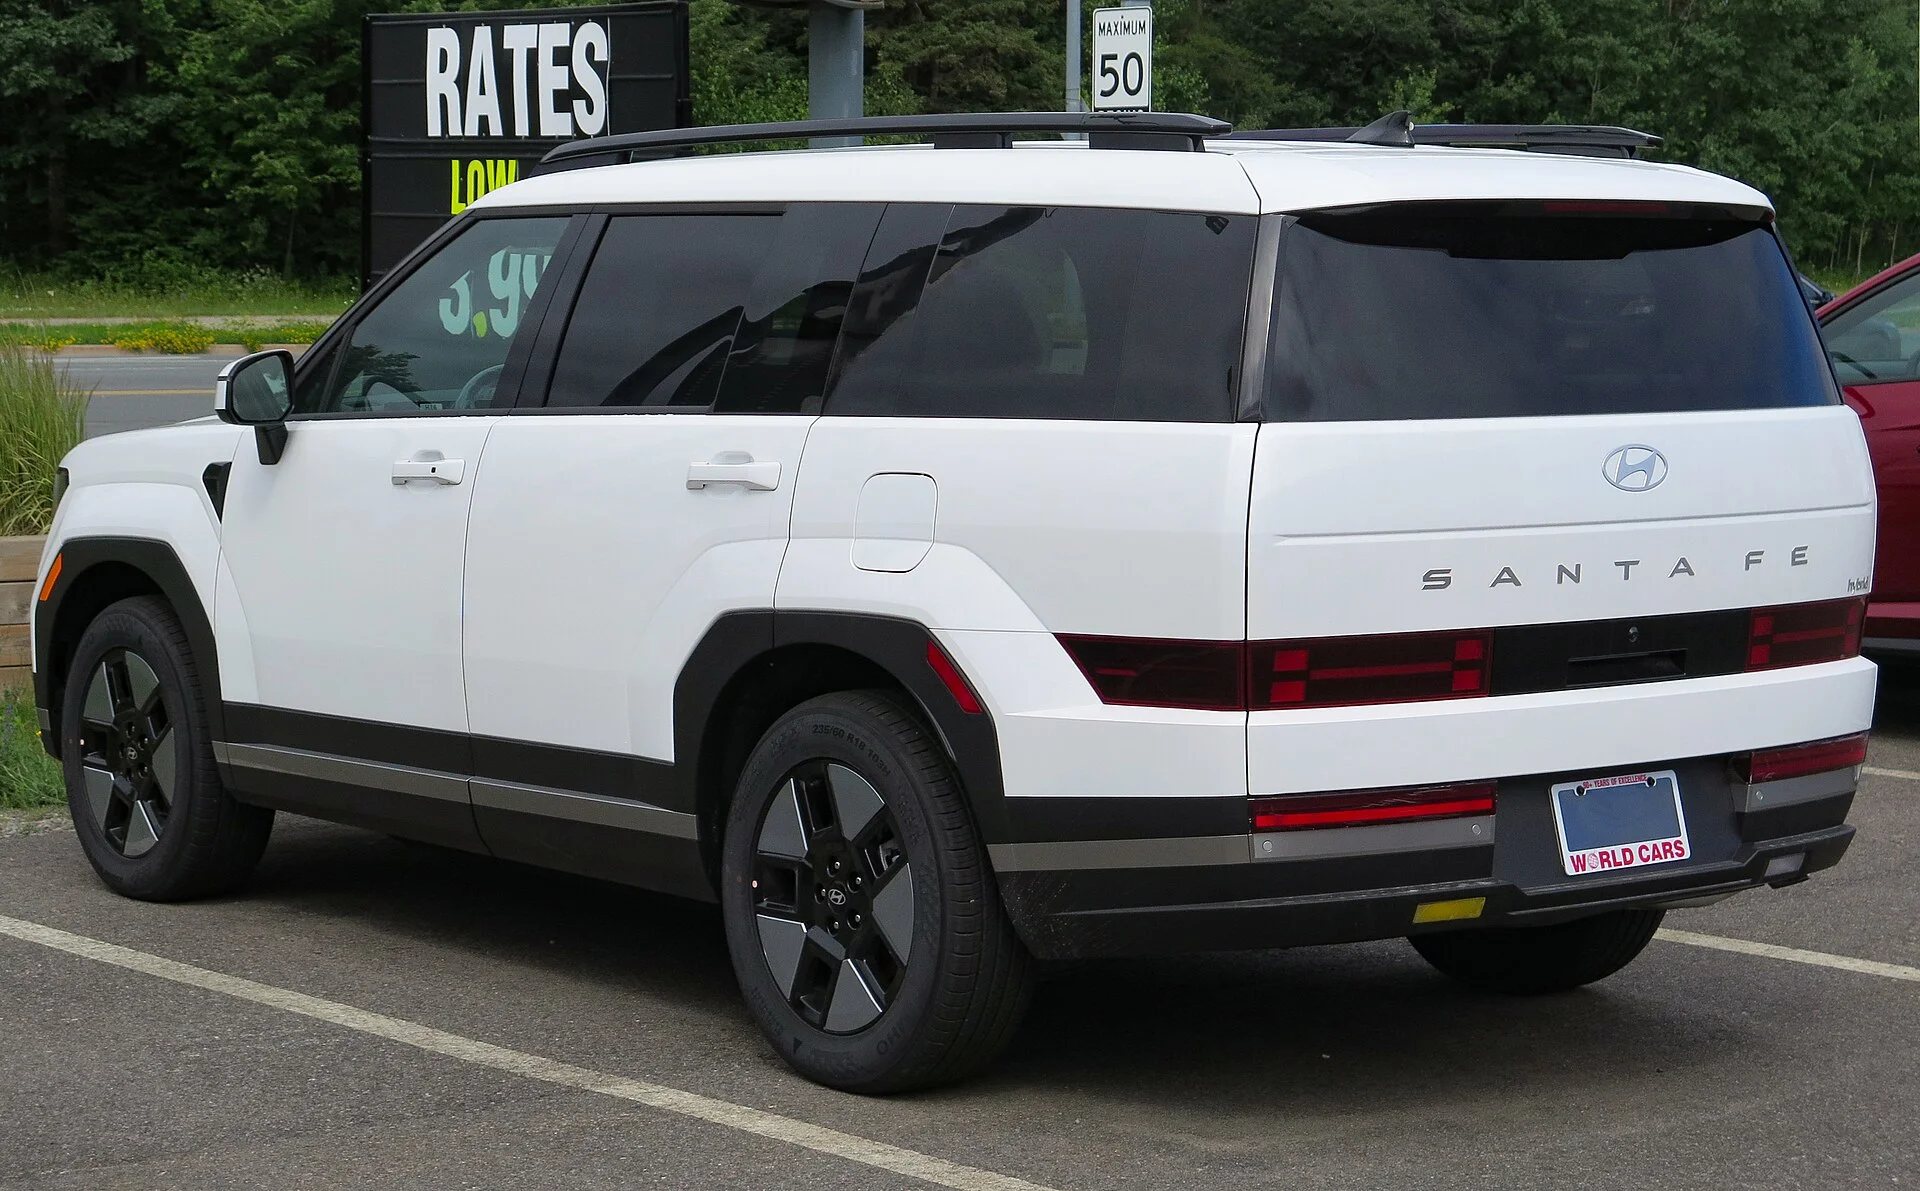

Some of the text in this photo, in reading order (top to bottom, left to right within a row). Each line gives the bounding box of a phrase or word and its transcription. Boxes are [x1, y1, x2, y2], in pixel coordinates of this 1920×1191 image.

[1098, 19, 1146, 37] MAXIMUM
[426, 21, 608, 138] RATES
[1099, 51, 1144, 98] 50
[1421, 545, 1809, 591] SANTA FE
[812, 723, 845, 739] 235/60
[846, 732, 867, 751] R18
[1594, 778, 1610, 788] YEARS
[1637, 839, 1686, 863] CARS
